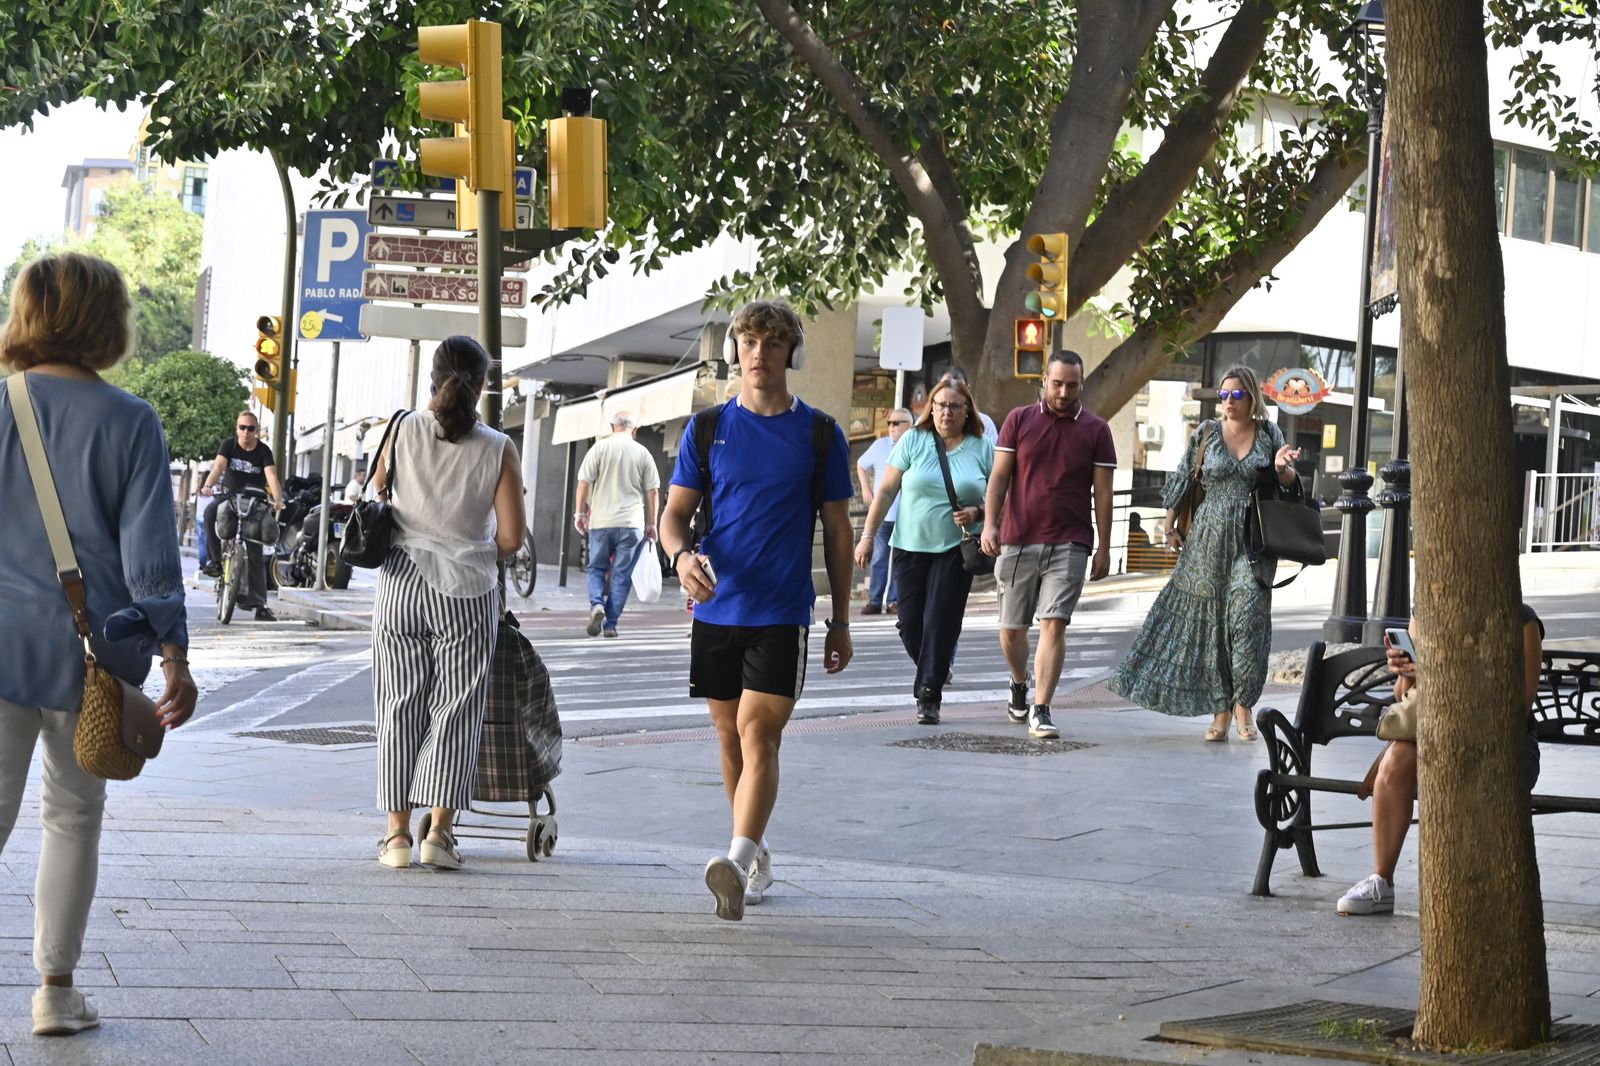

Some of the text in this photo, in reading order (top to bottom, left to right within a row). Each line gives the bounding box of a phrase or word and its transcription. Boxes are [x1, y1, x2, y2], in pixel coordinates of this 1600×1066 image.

[316, 218, 360, 283] P
[443, 251, 458, 264] El
[507, 282, 520, 290] de
[305, 288, 336, 298] PABLO
[431, 286, 520, 304] La Soad
